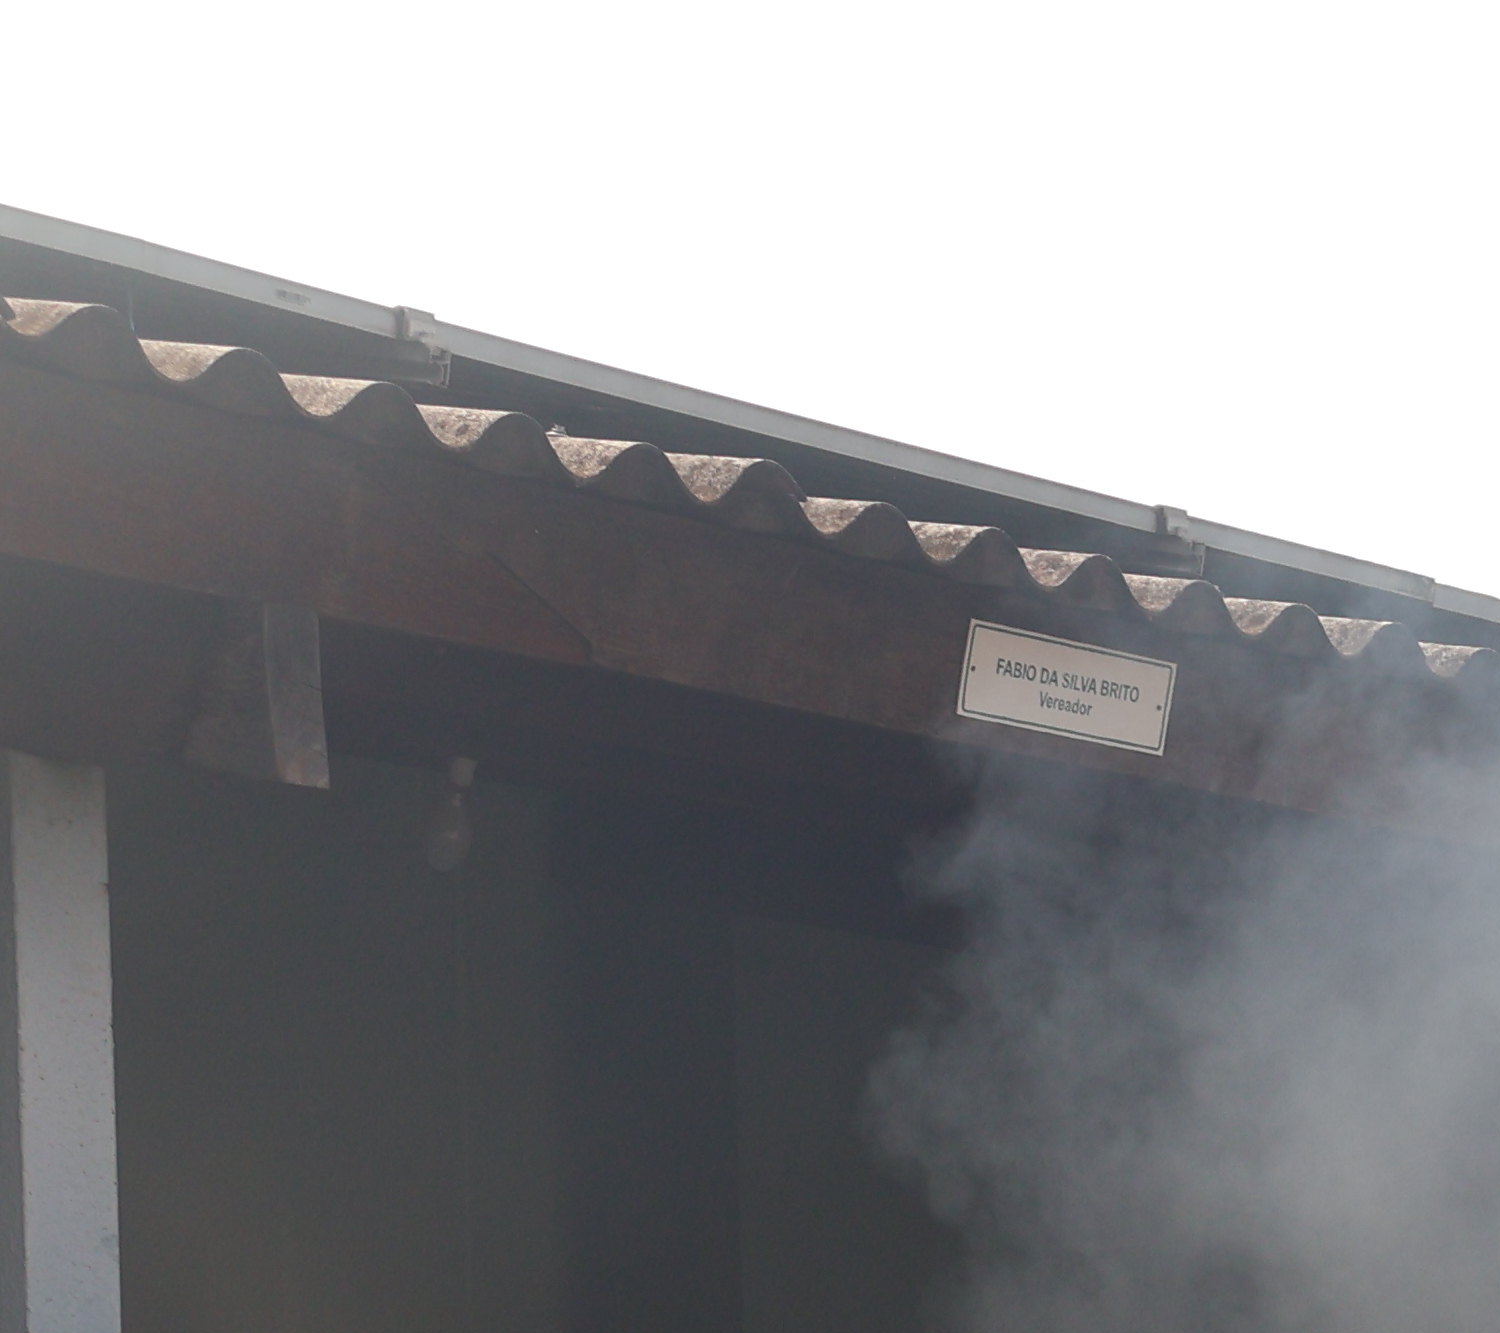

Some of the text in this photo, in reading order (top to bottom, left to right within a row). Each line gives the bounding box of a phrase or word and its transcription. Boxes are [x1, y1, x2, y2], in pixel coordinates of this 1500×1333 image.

[996, 657, 1140, 703] FABIO DA SILVA BRITO
[1039, 690, 1093, 716] Vereador
